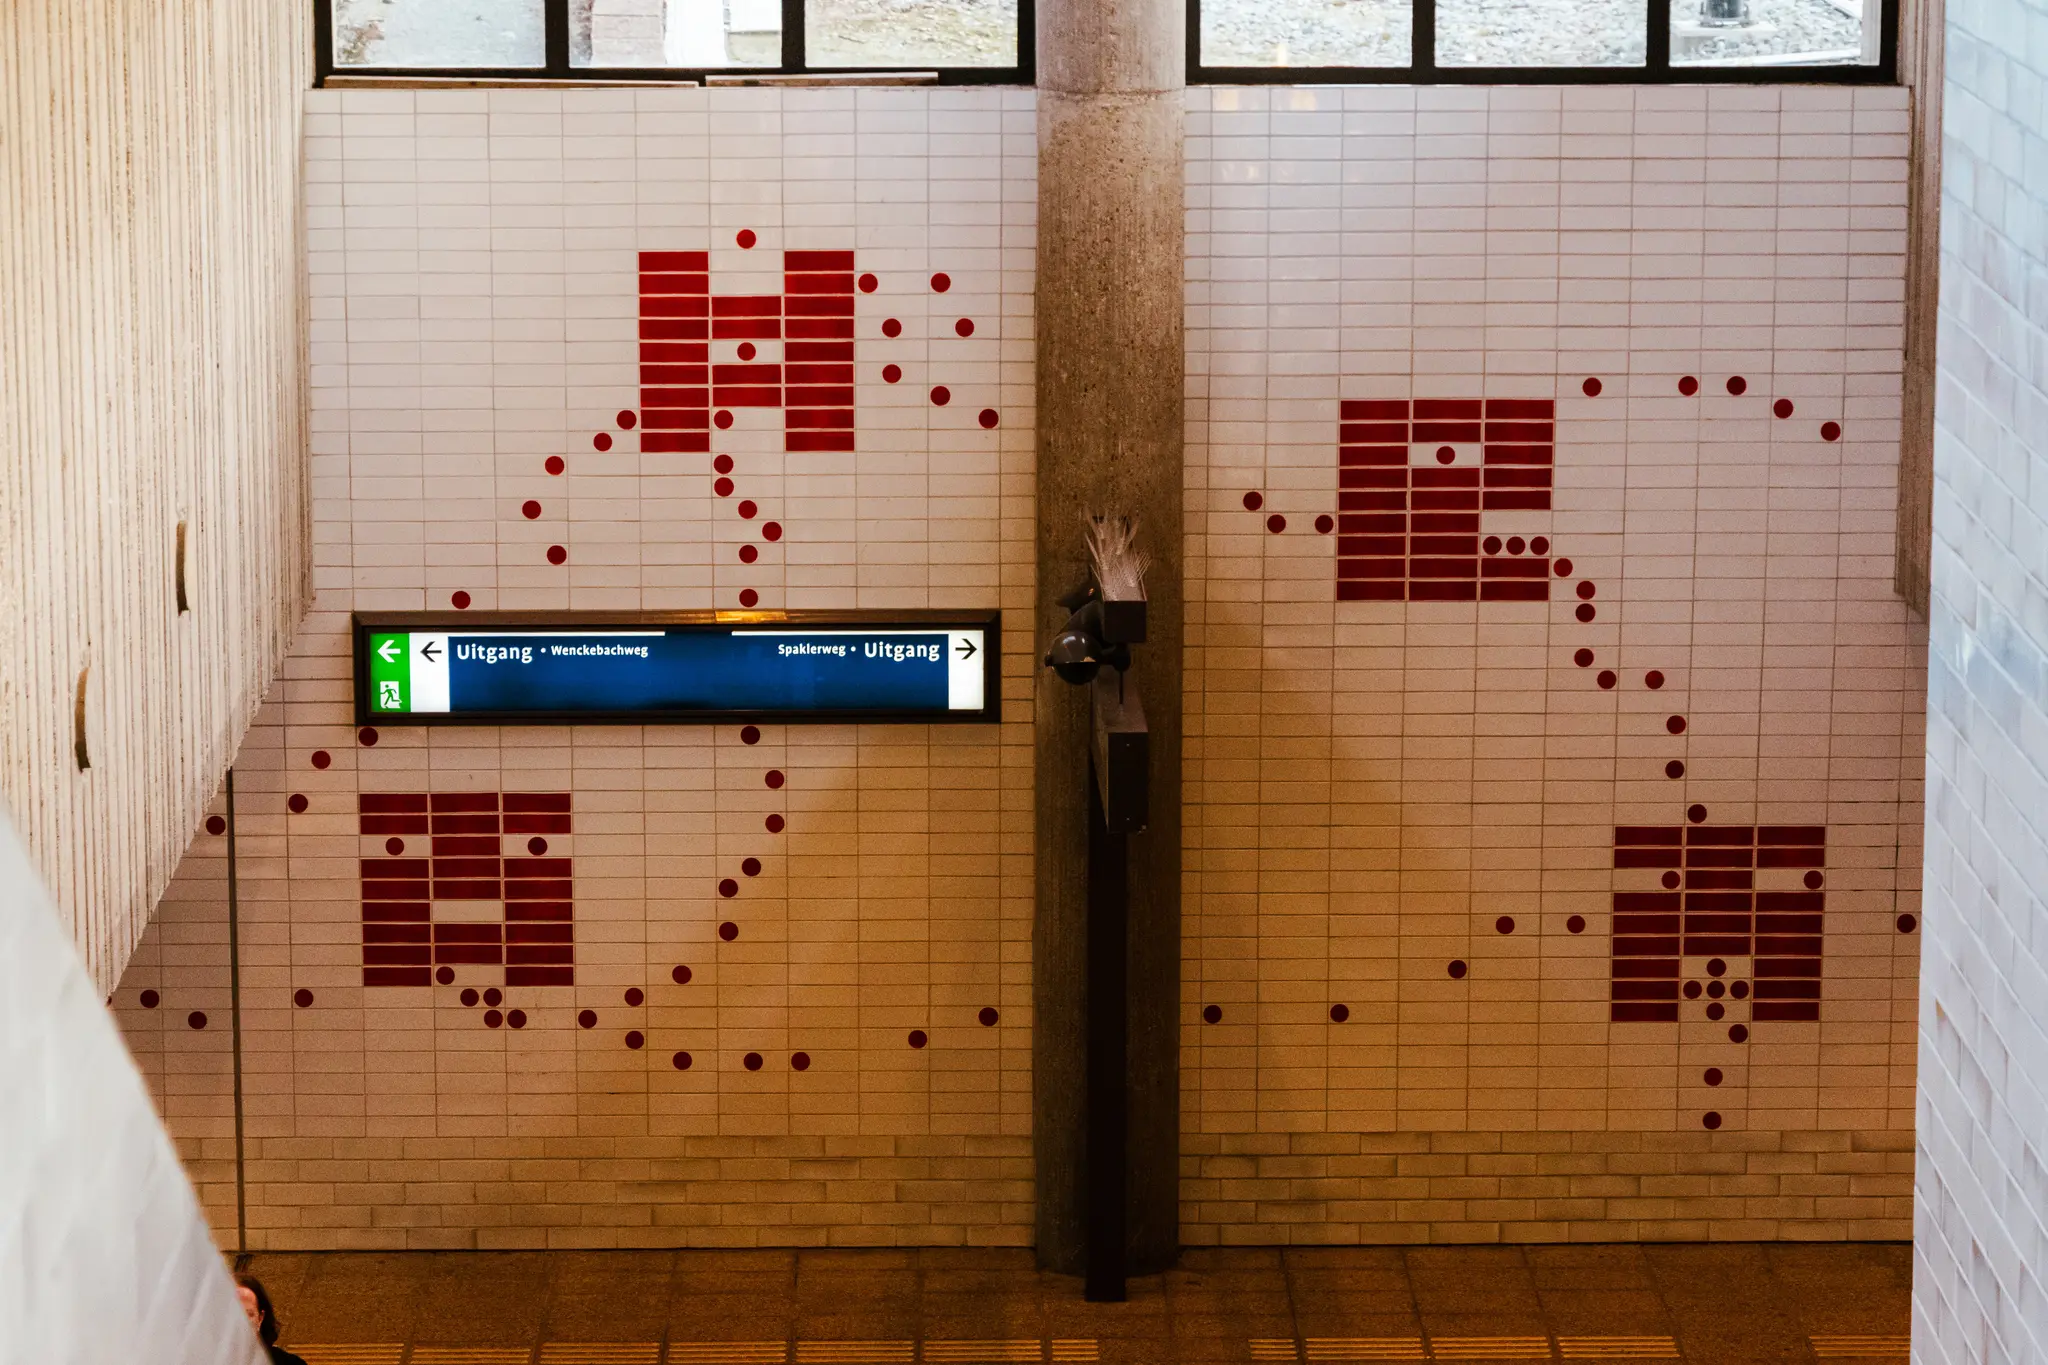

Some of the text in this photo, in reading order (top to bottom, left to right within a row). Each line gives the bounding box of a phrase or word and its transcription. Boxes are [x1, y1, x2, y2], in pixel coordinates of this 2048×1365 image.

[456, 643, 649, 664] Uitgang Wenckebachweg
[777, 641, 940, 662] Spaklerweg Uitgang
